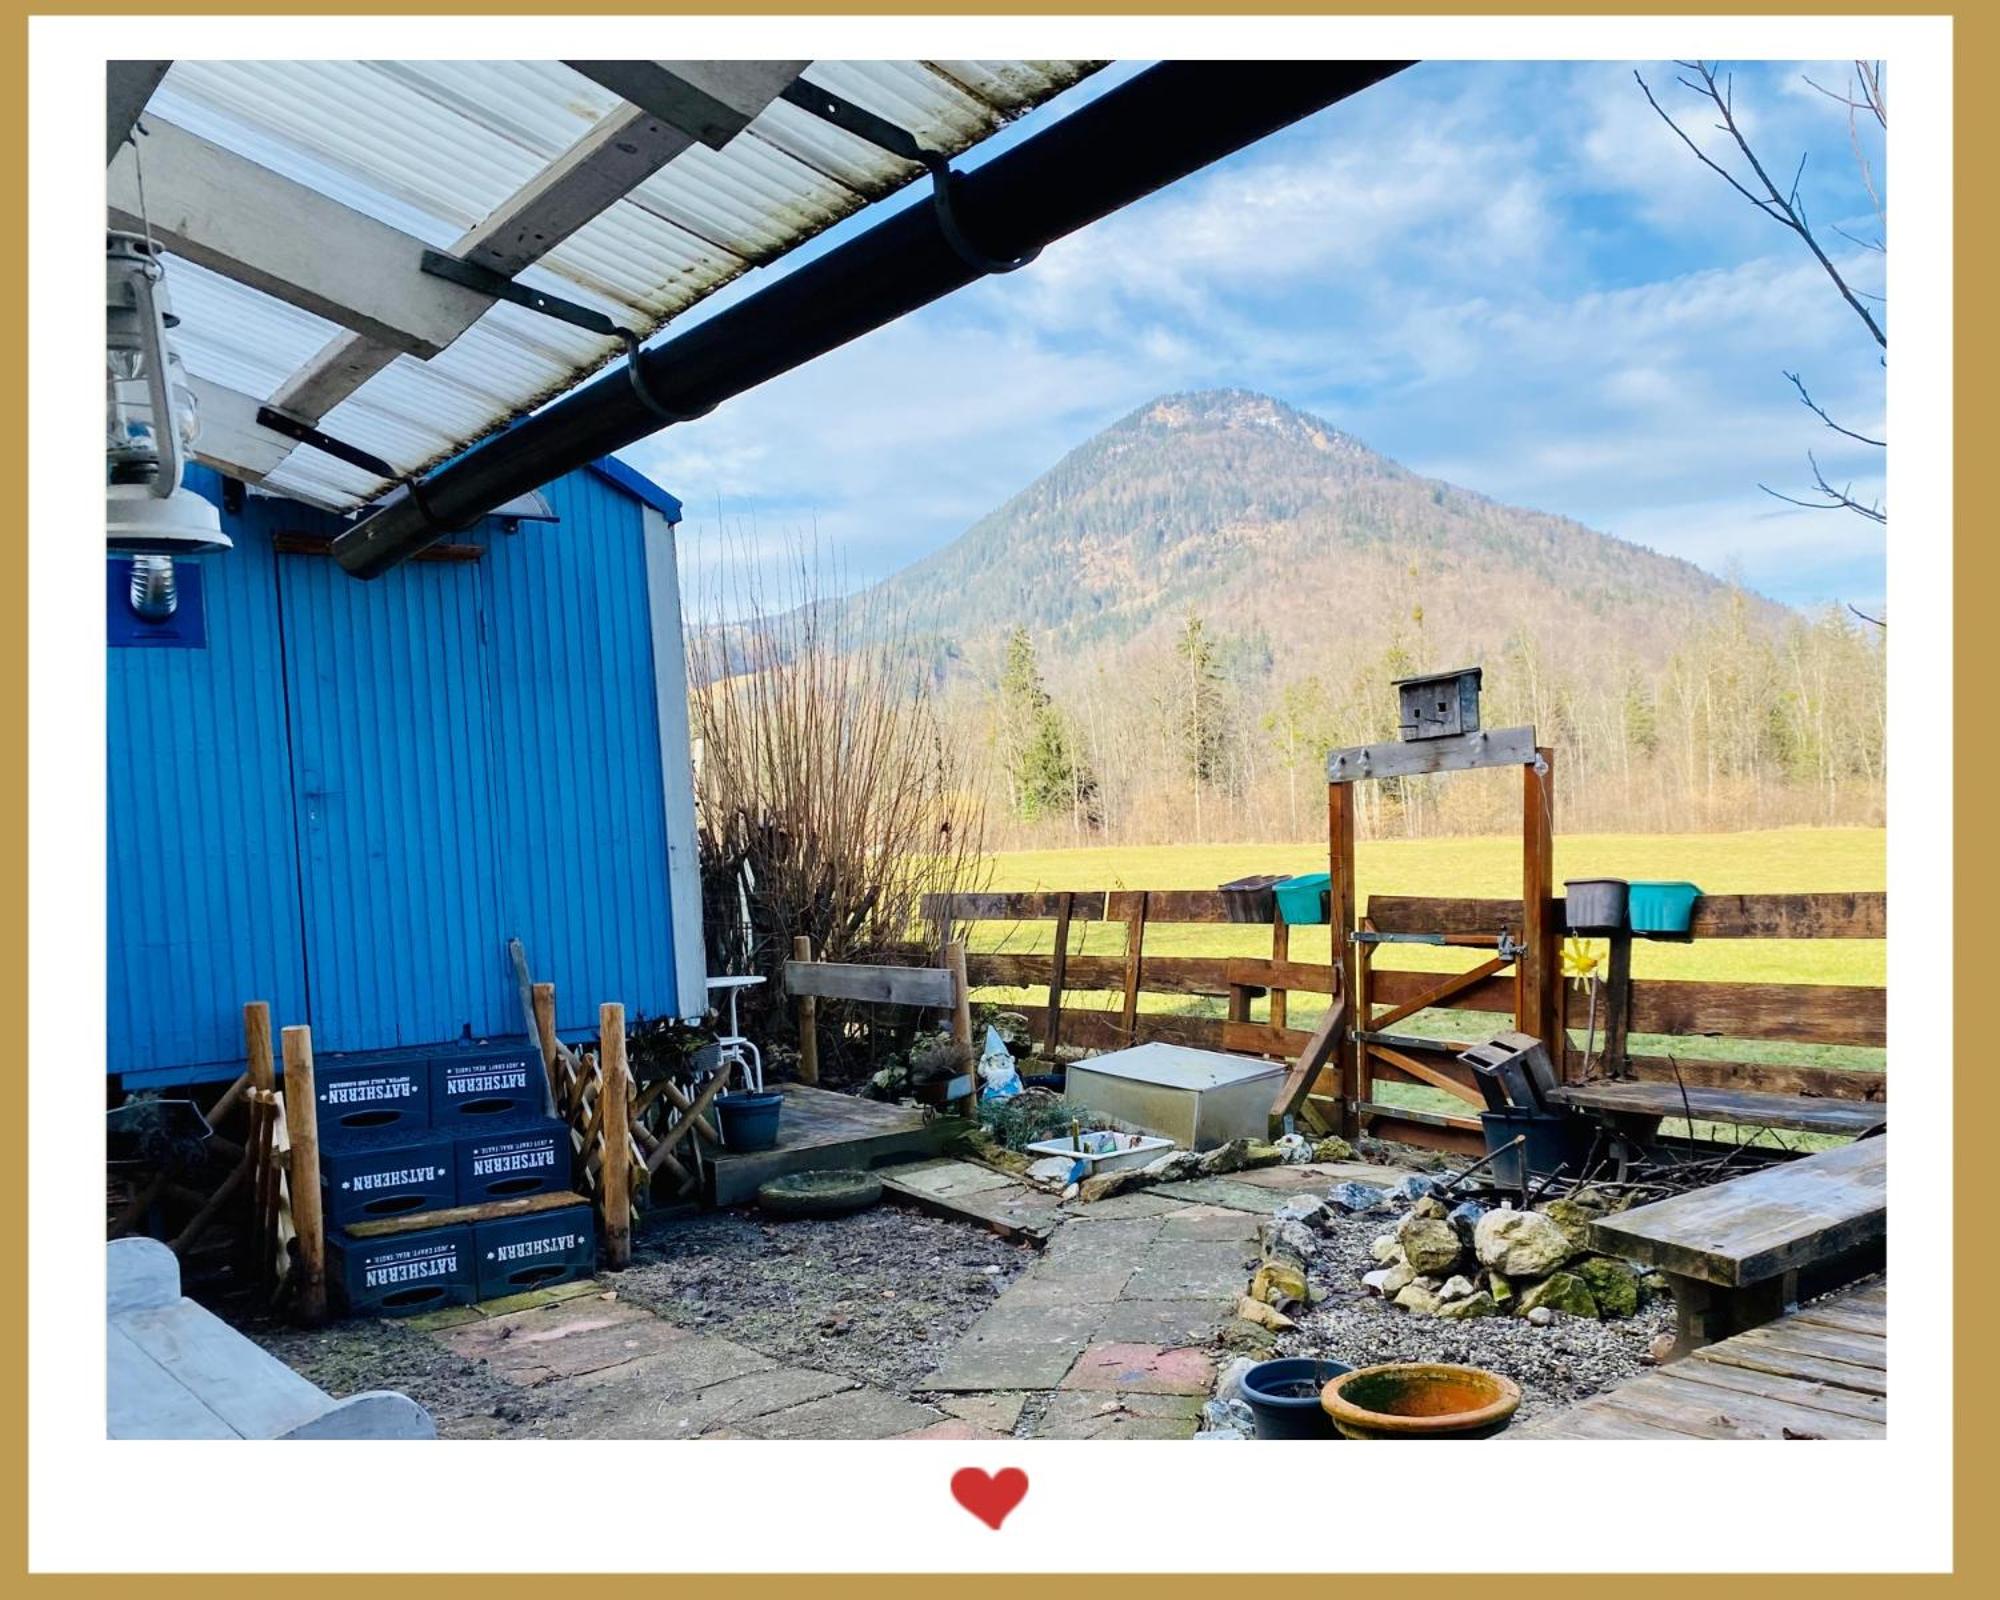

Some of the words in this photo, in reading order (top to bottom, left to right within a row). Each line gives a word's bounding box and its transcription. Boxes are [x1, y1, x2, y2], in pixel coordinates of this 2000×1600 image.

[328, 1083, 410, 1104] RATSHERRN
[447, 1073, 527, 1094] RATSHERRN
[473, 1150, 555, 1175] RATSHERRN
[353, 1166, 434, 1191] RATSHERRN
[498, 1234, 575, 1261] RATSHERRN
[366, 1256, 457, 1287] RATSHERRN
